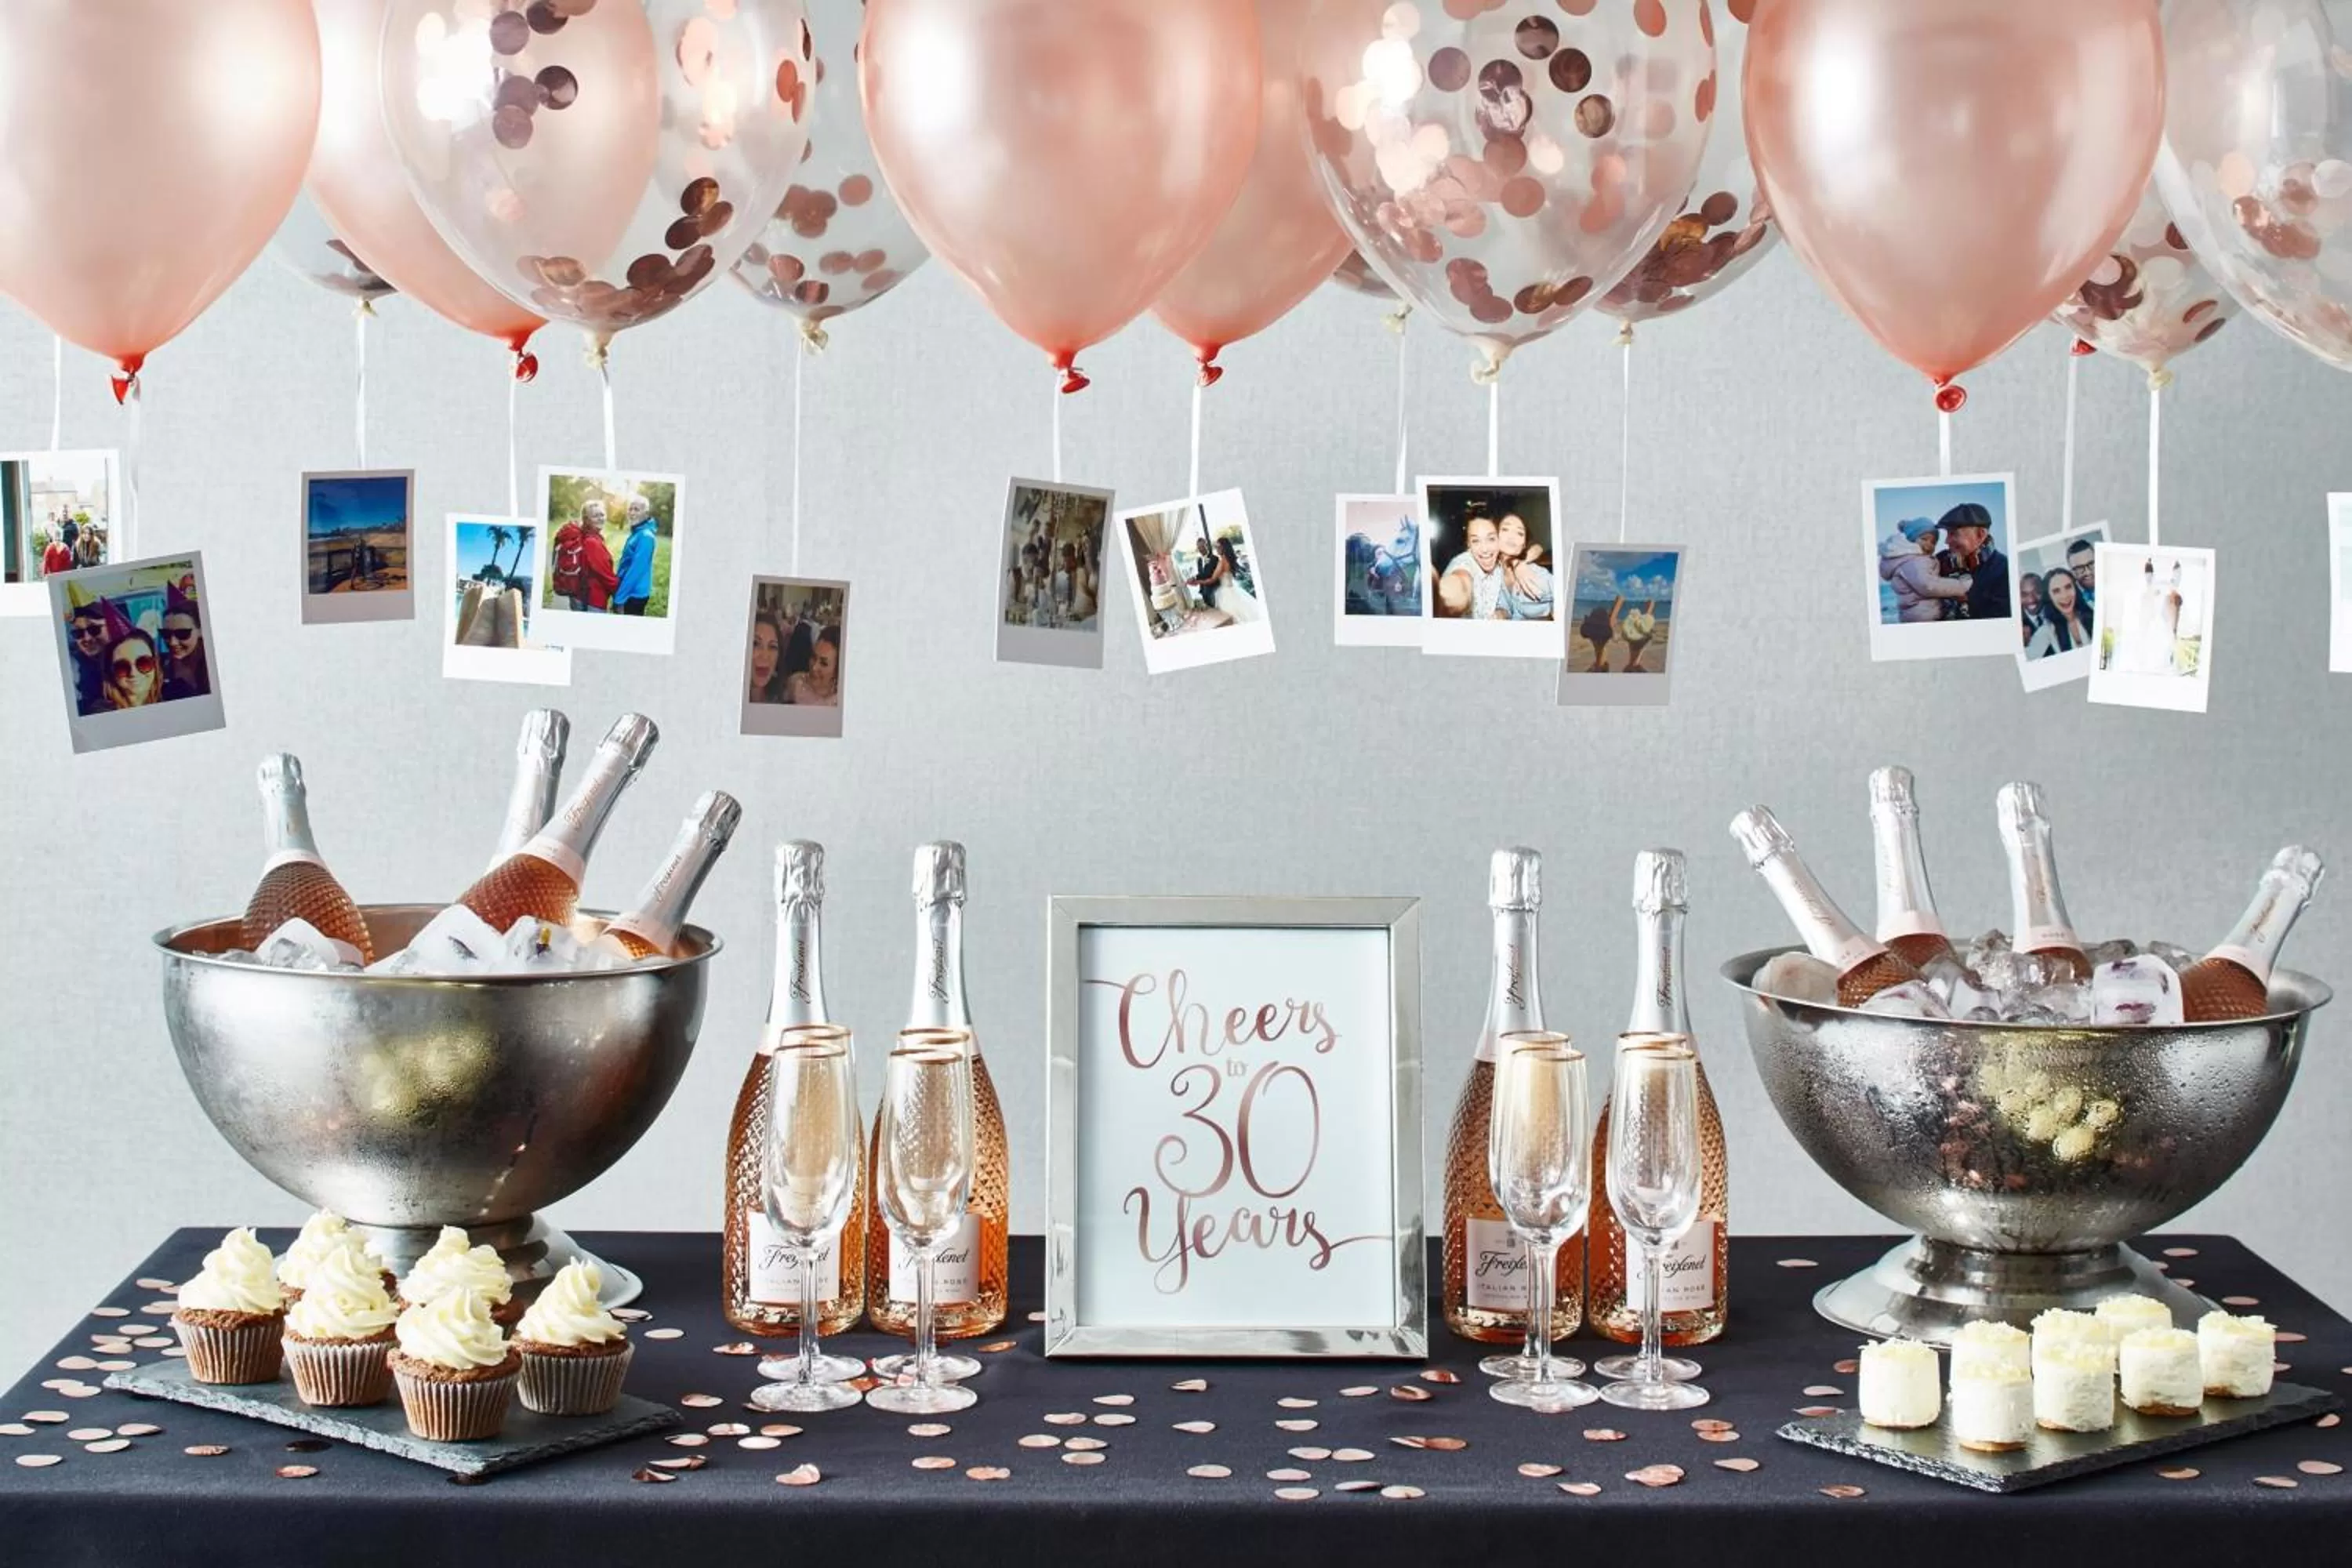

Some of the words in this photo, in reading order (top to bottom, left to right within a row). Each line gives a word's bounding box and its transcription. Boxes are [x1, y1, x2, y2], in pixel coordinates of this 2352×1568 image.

[1083, 968, 1342, 1069] Cheers
[1226, 1058, 1248, 1077] to
[1154, 1061, 1319, 1199] 30
[758, 1244, 830, 1270] Freiet
[1123, 1186, 1392, 1294] Years
[1475, 1250, 1528, 1277] Freixe
